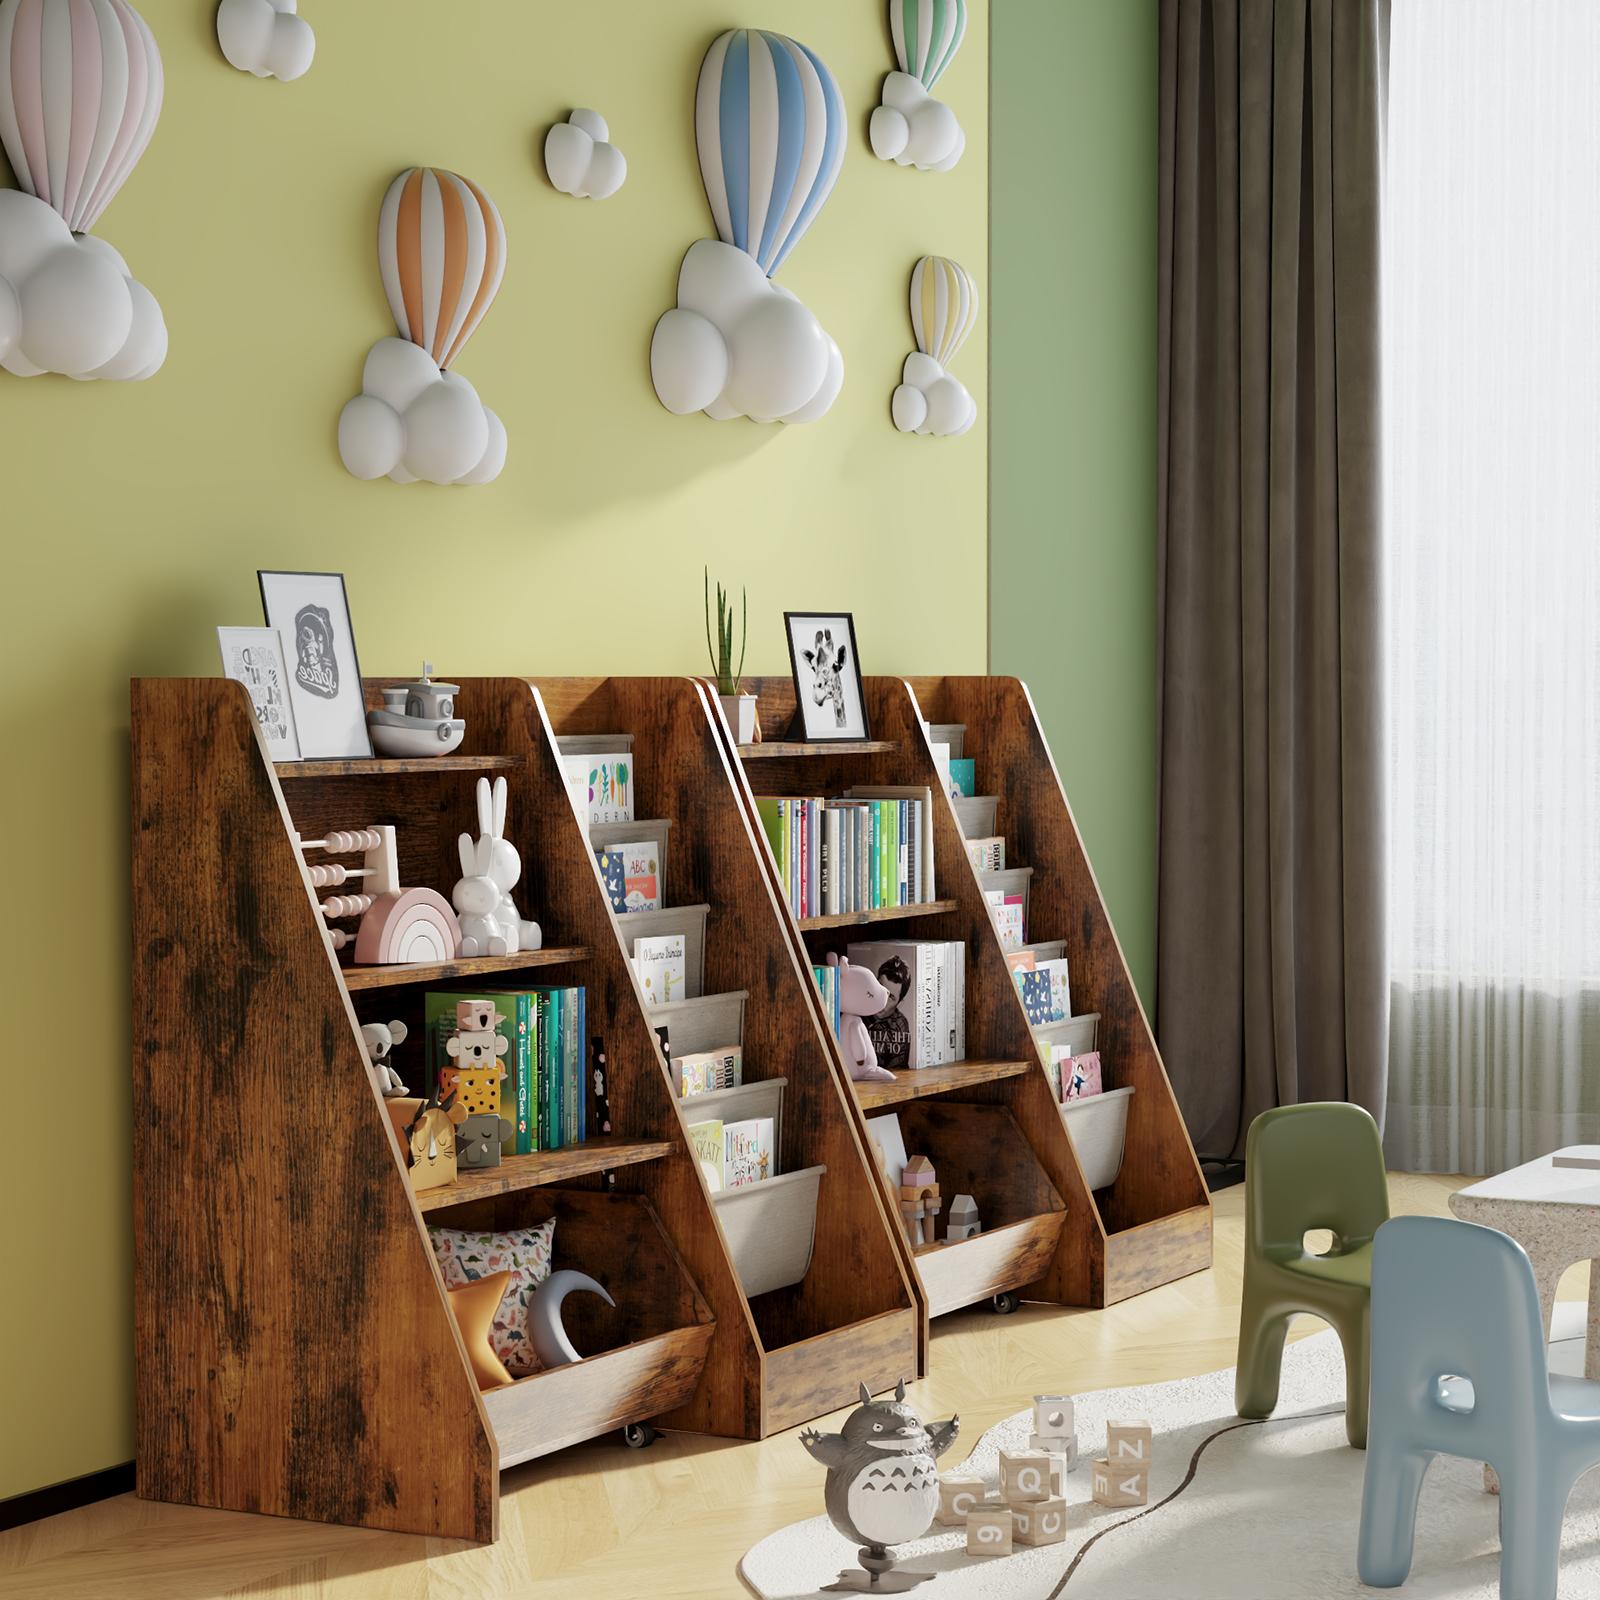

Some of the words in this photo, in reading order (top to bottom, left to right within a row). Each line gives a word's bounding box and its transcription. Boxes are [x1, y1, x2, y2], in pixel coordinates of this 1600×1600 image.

[1017, 1467, 1041, 1495] Q
[1119, 1473, 1141, 1497] A
[1041, 1511, 1061, 1535] C
